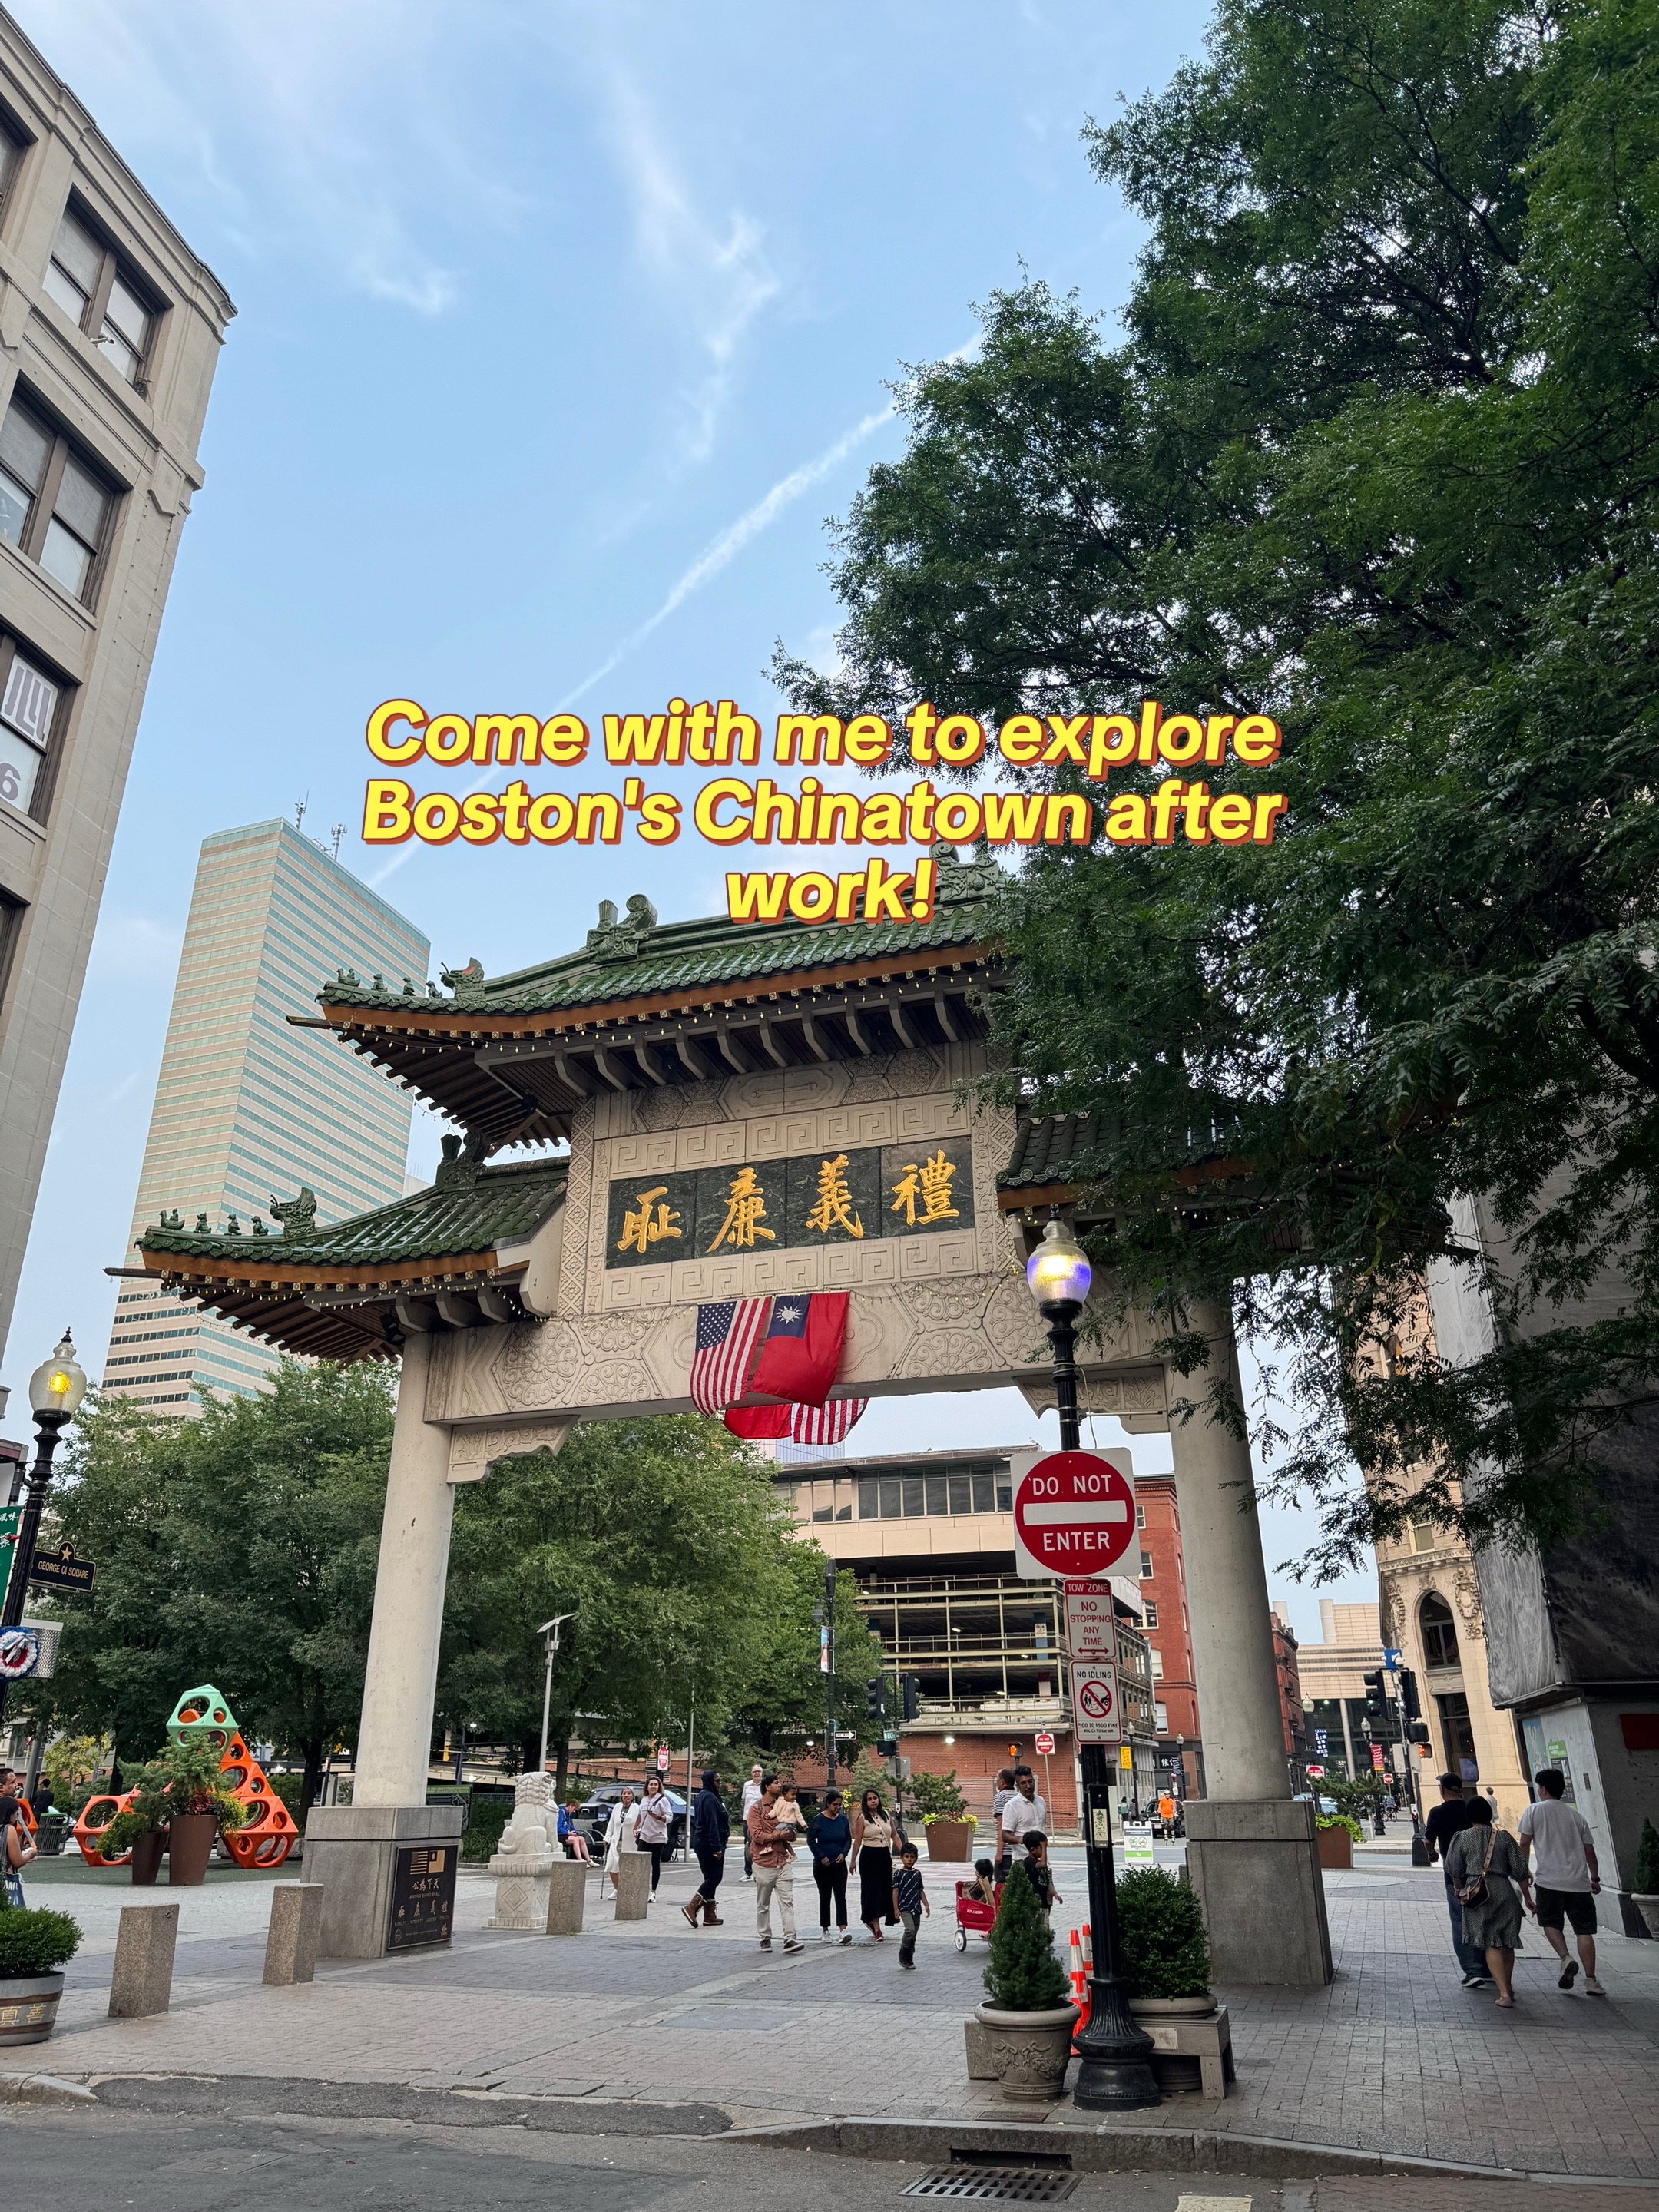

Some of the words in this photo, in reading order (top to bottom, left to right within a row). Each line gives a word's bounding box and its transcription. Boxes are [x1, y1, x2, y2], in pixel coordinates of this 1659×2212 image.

[1032, 1477, 1059, 1495] DO
[1073, 1475, 1112, 1494] NOT
[1043, 1532, 1111, 1551] ENTER
[38, 1560, 61, 1573] GEORGE
[61, 1565, 68, 1575] OI
[68, 1567, 89, 1579] SQUARE
[1067, 1583, 1084, 1592] TOW
[1087, 1583, 1108, 1592] ZONE
[1081, 1601, 1098, 1611] NO
[1070, 1614, 1111, 1623] STOPPING
